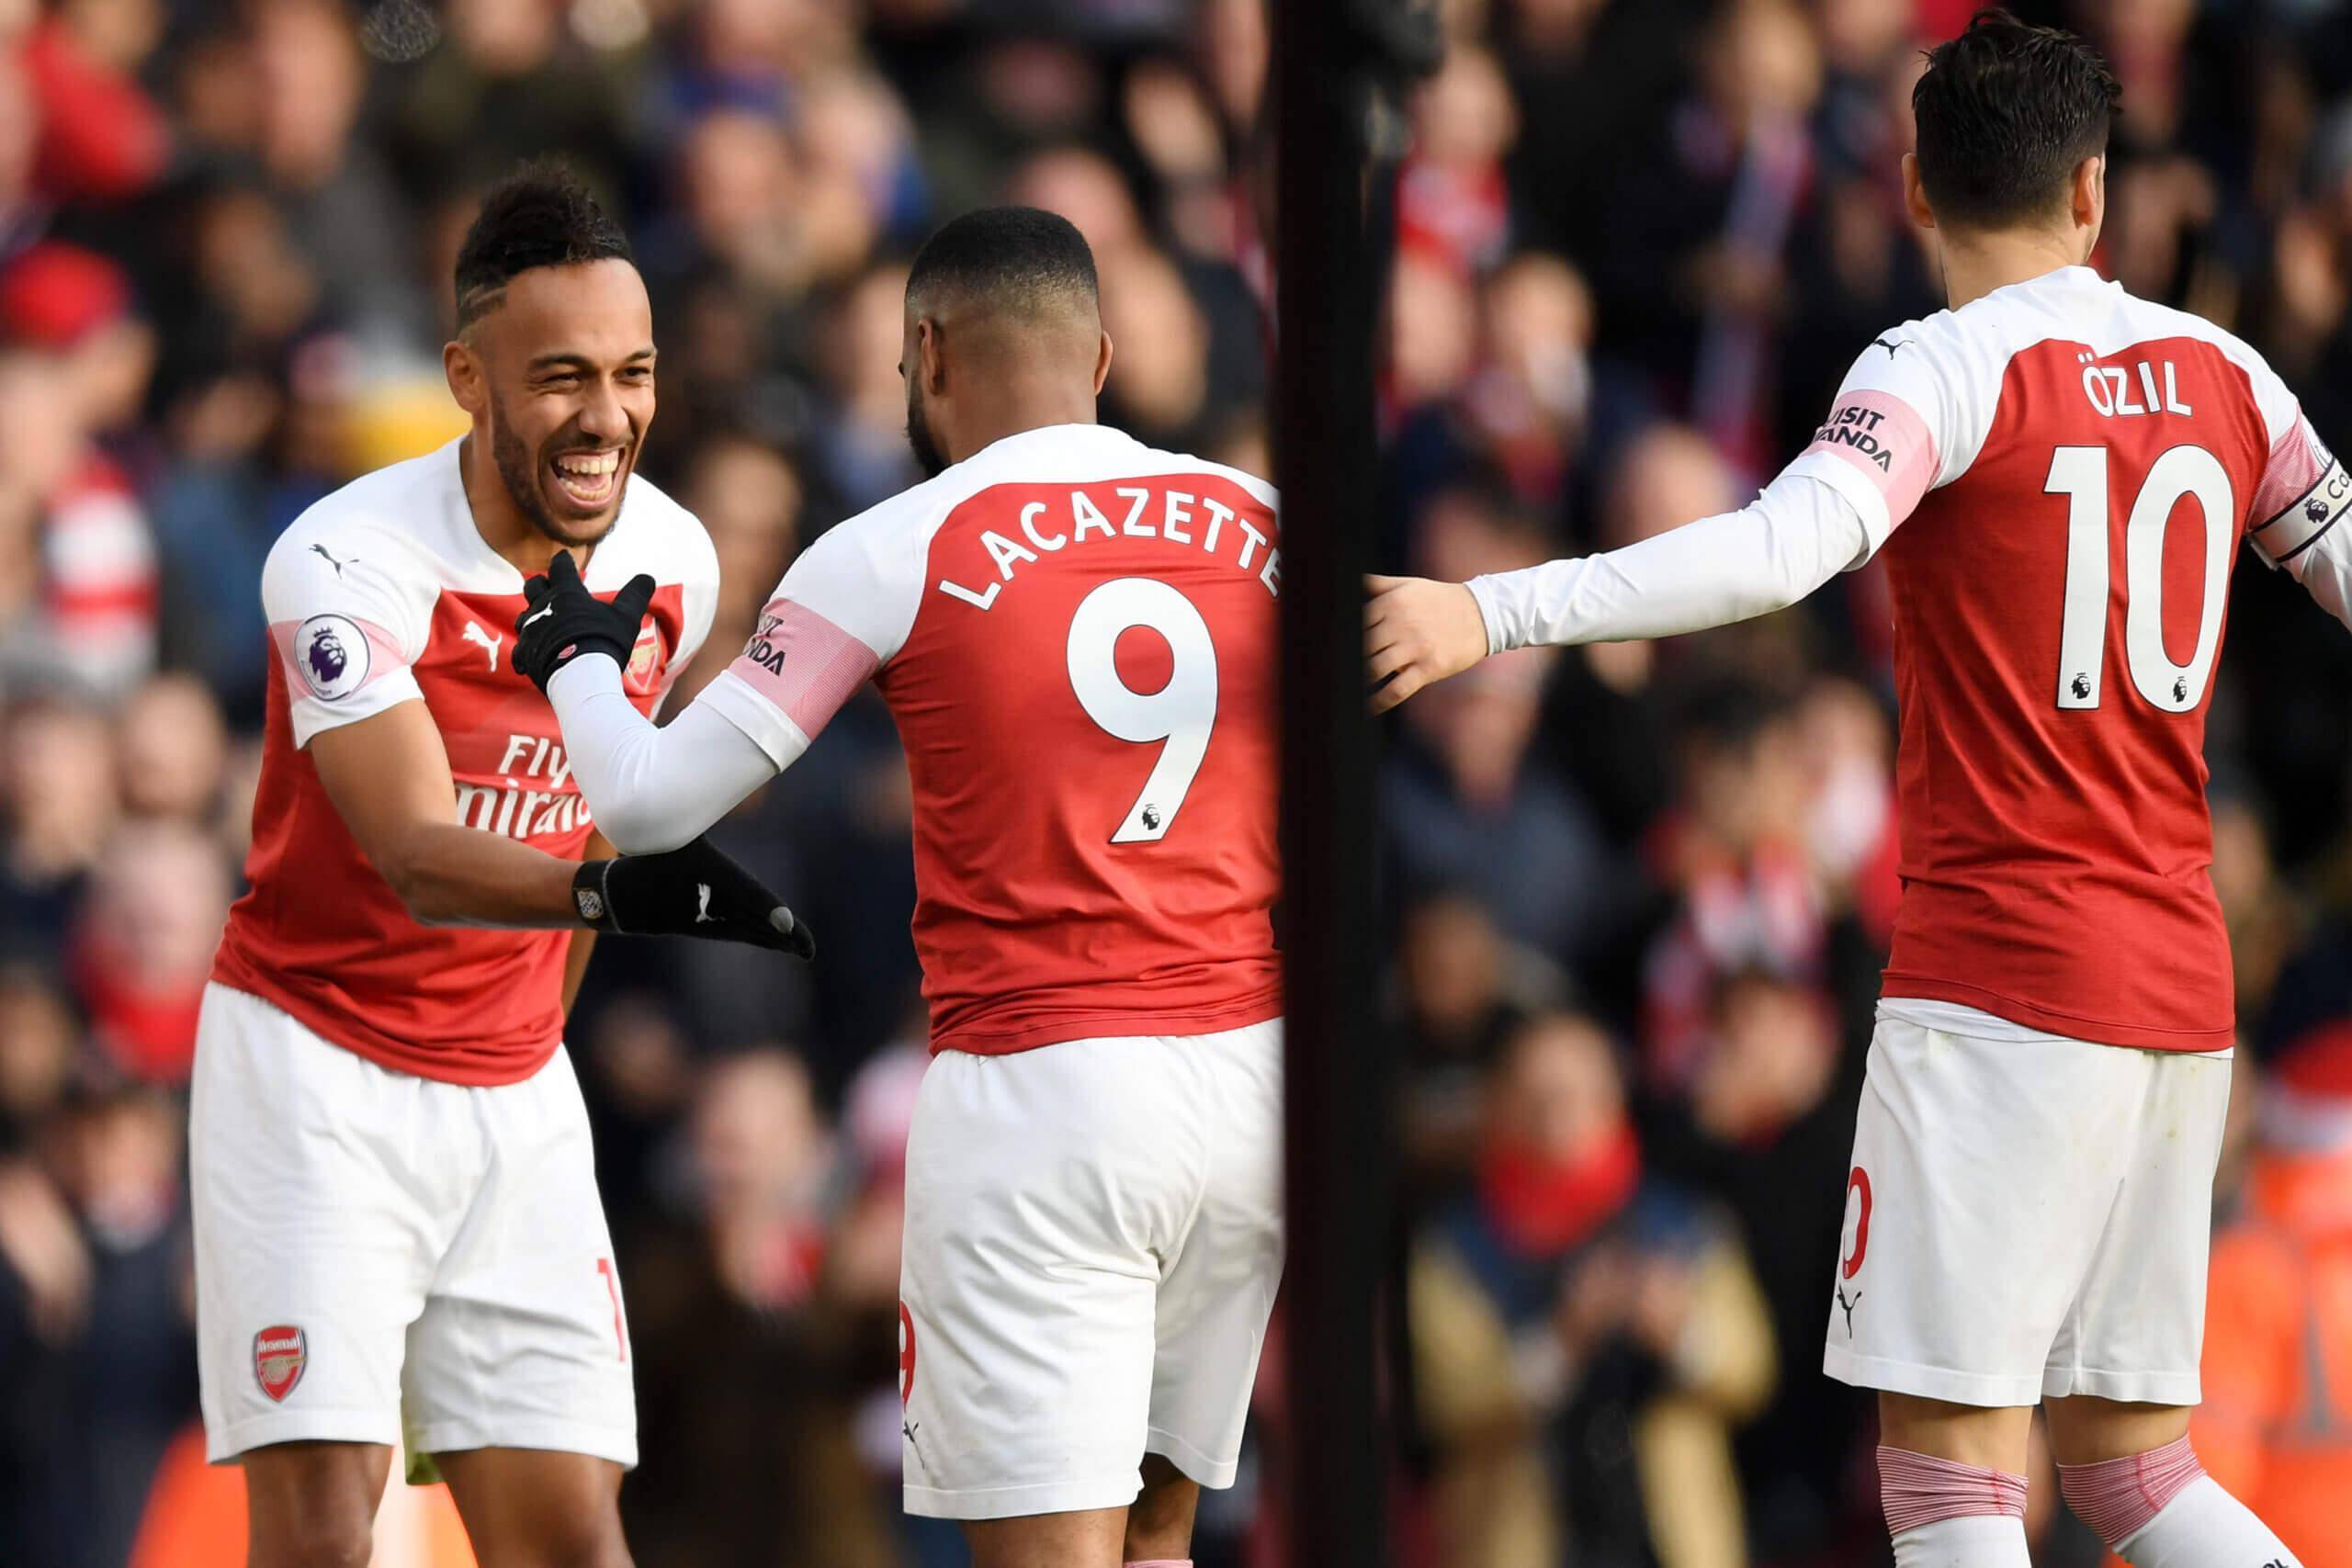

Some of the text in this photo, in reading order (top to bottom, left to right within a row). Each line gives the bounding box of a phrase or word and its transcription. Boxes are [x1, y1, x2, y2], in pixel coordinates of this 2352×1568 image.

[2076, 351, 2193, 419] ÖZIL
[2042, 443, 2235, 714] 10
[497, 734, 571, 789] Fly
[1066, 576, 1220, 845] 9
